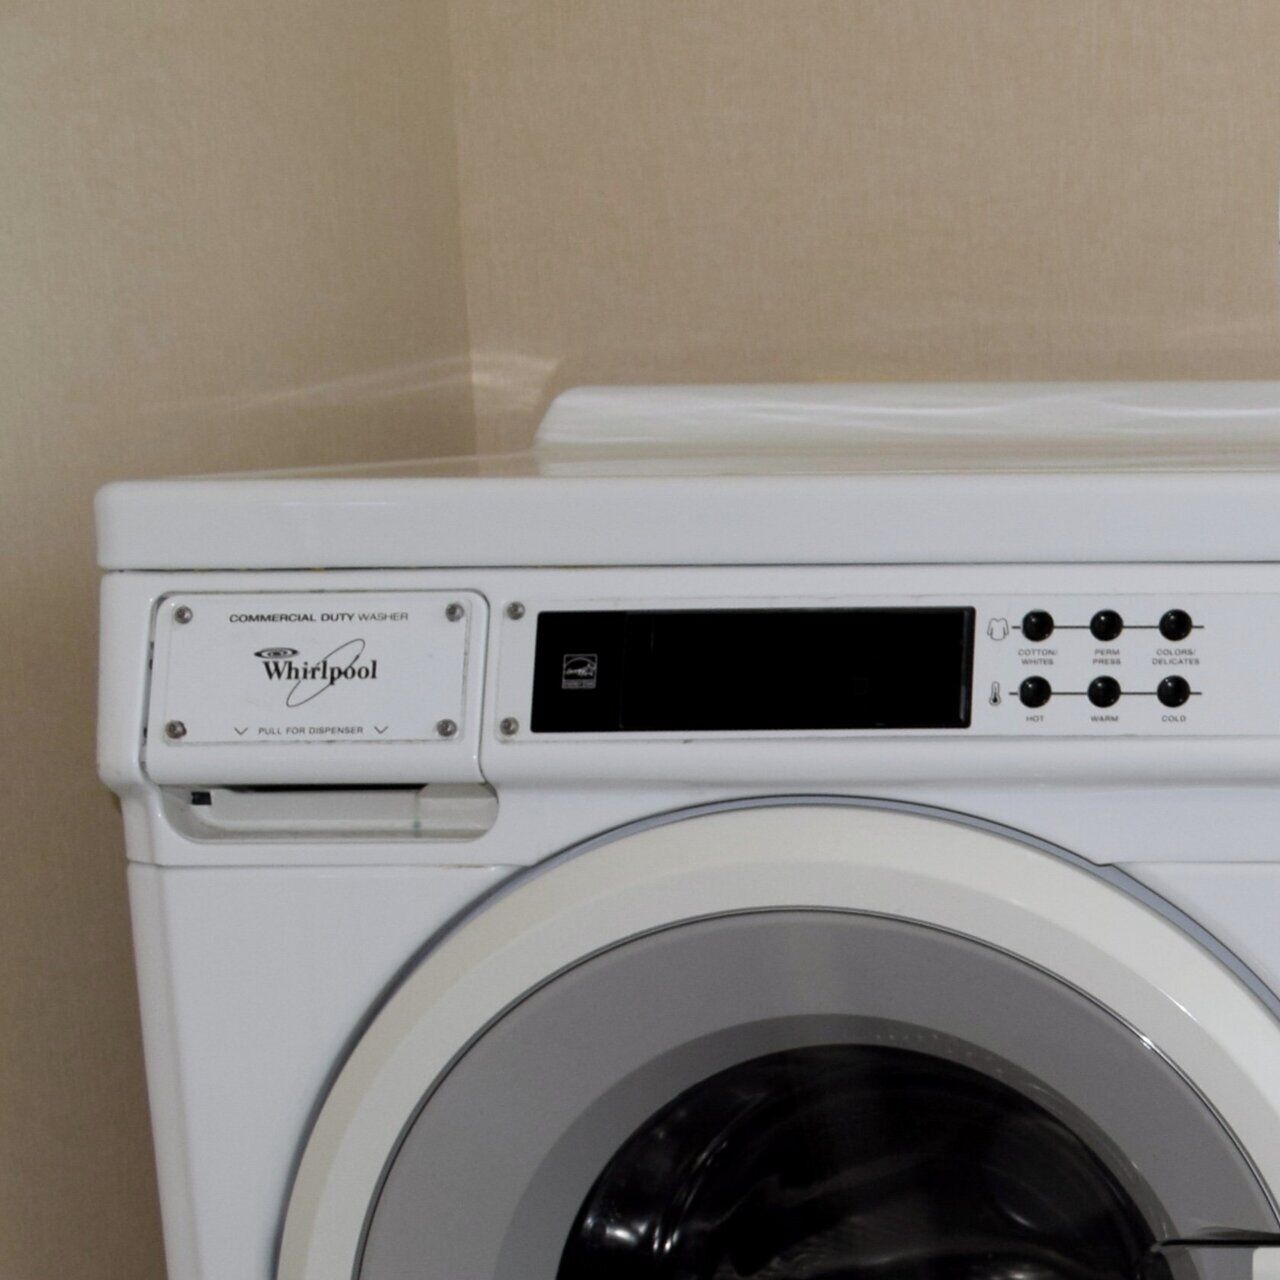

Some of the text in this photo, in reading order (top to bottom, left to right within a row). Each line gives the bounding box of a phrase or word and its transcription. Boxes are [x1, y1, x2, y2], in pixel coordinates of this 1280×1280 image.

[229, 611, 409, 623] COMMERCIAL DUTY WASHER
[1094, 648, 1121, 657] PERM
[1092, 657, 1122, 666] PRESS
[1151, 657, 1200, 666] DELICATES
[262, 659, 378, 685] Whirlpool
[1025, 714, 1044, 723] HOT
[1090, 714, 1119, 723] WARM
[258, 726, 364, 736] PULL FOR DISPENSER
